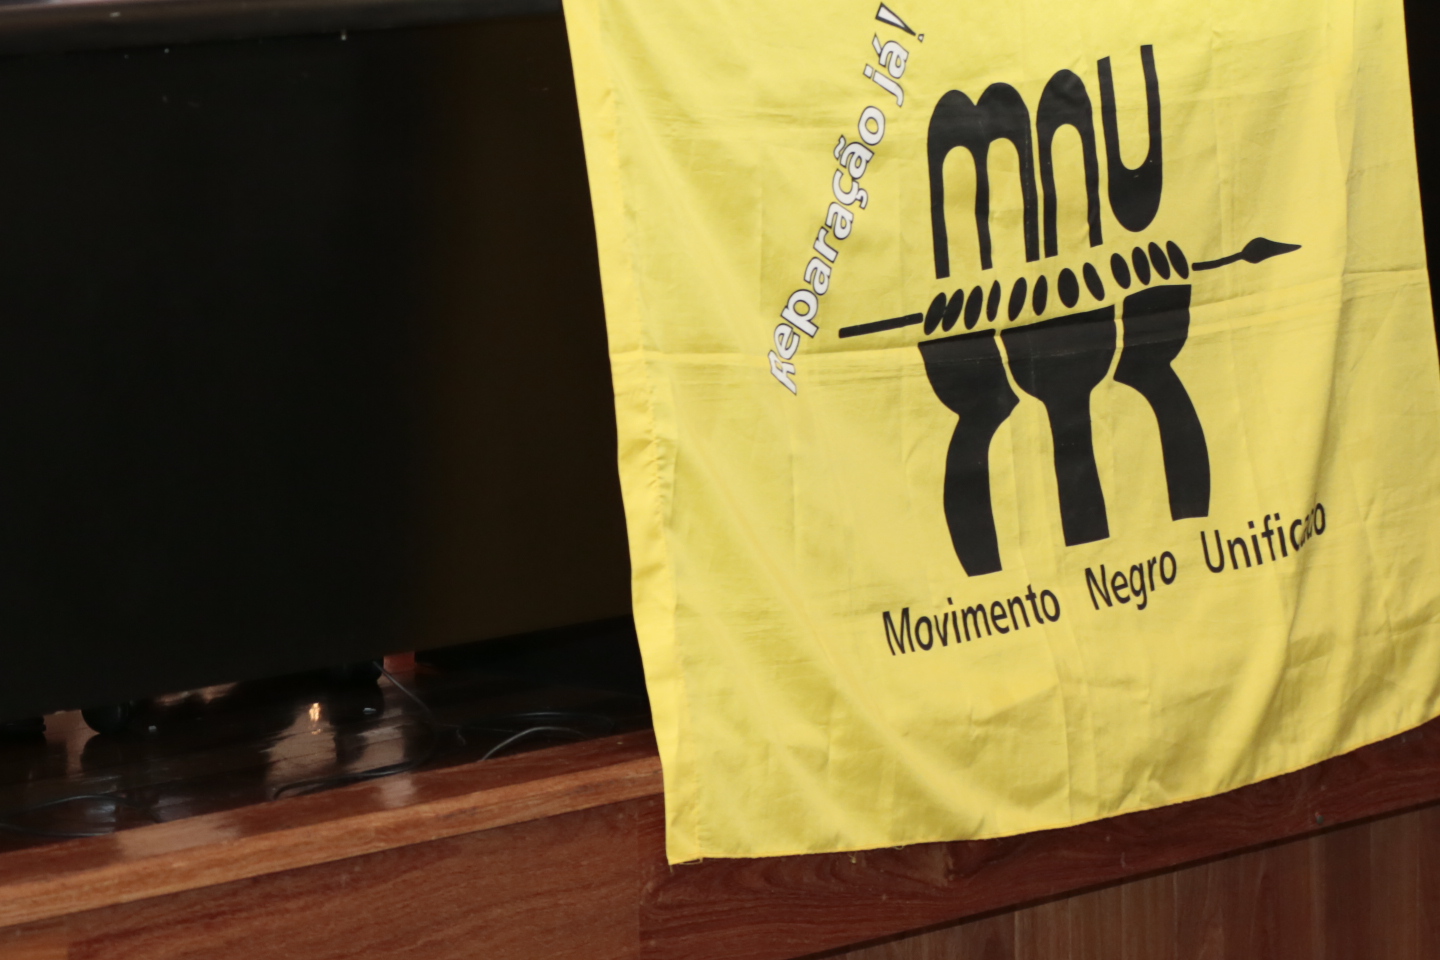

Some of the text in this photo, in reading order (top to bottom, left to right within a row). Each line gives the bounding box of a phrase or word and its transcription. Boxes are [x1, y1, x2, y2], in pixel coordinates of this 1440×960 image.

[767, 105, 886, 396] Reparação
[882, 584, 1061, 656] Movimento
[1084, 550, 1177, 610] Negro
